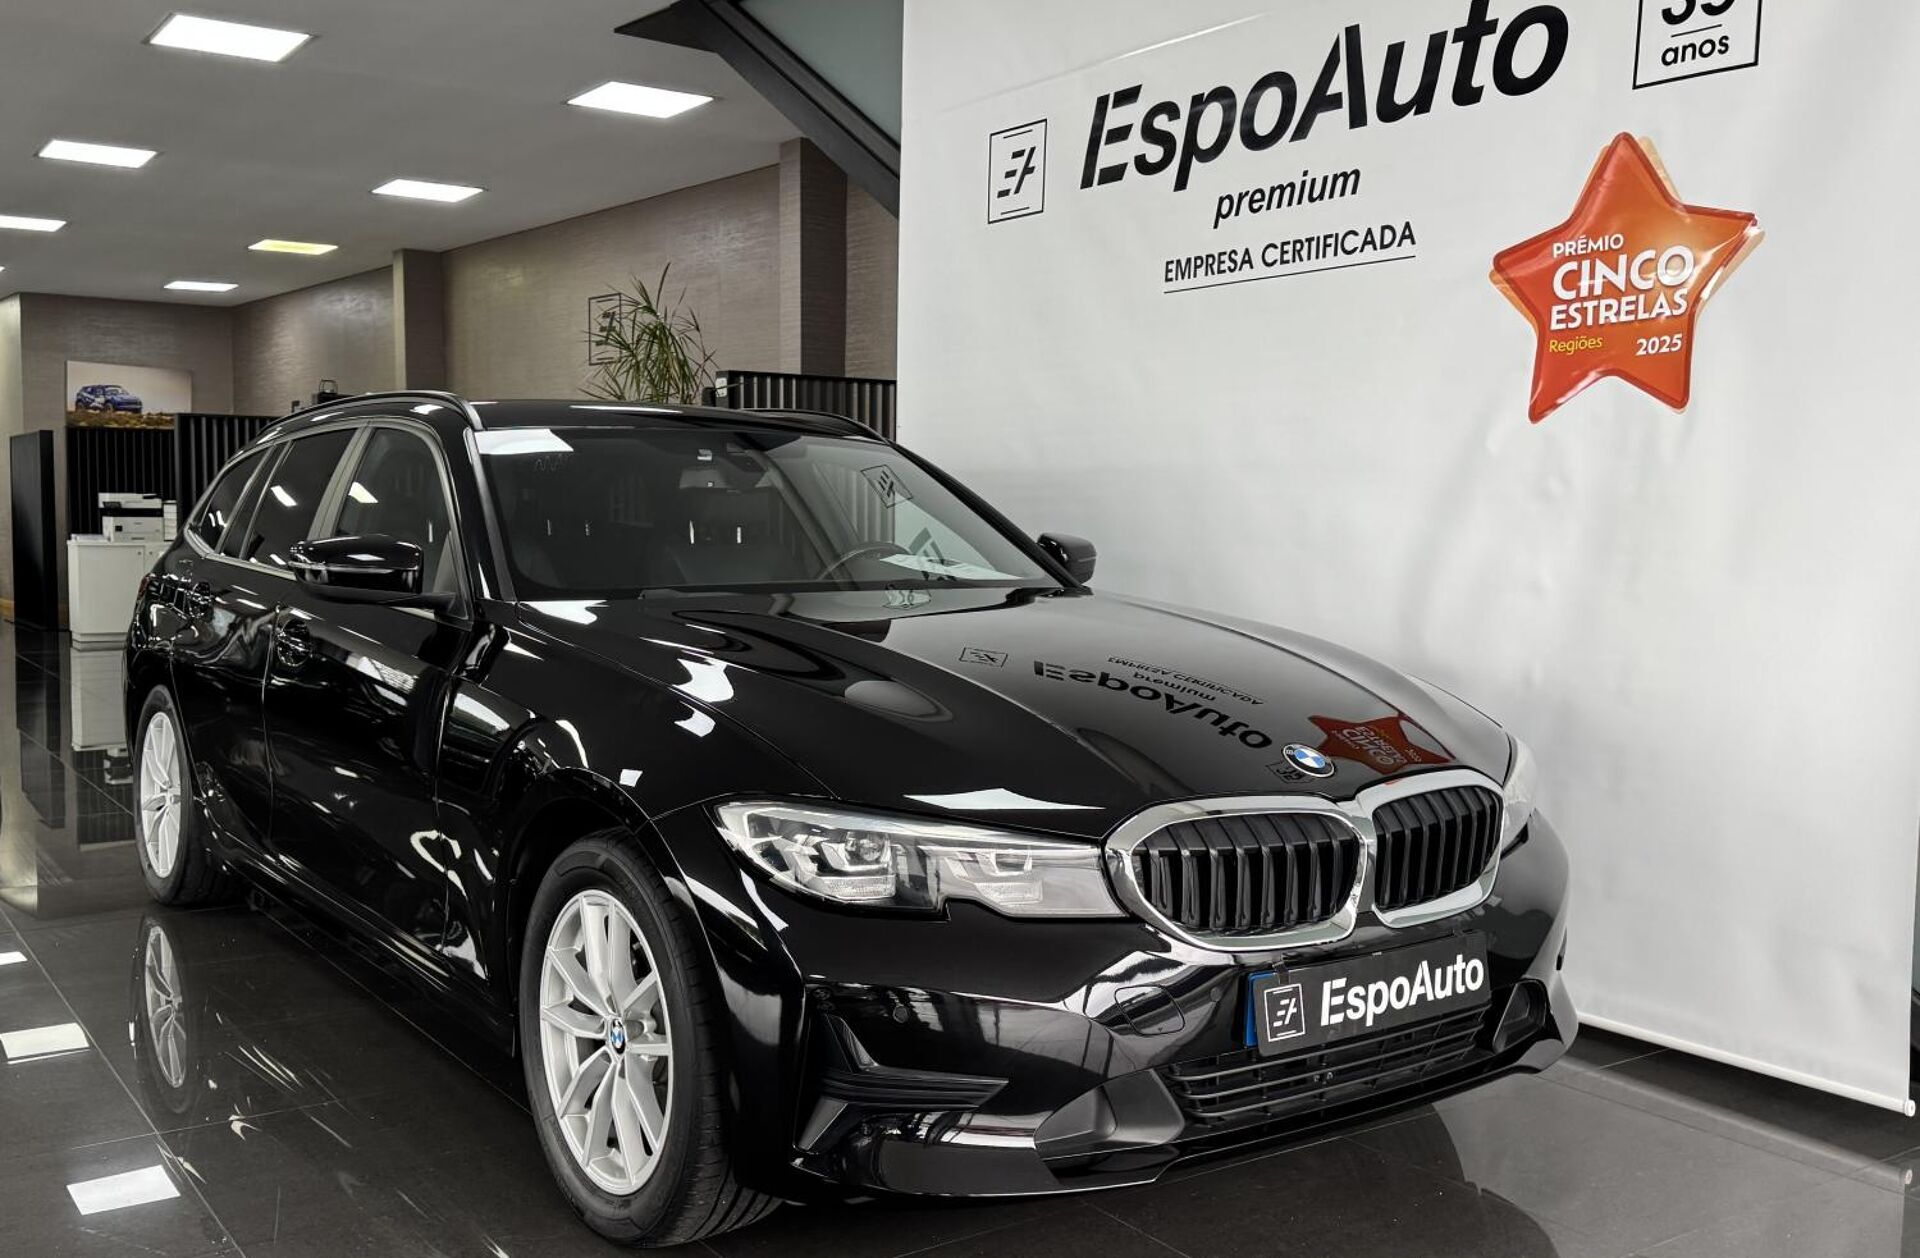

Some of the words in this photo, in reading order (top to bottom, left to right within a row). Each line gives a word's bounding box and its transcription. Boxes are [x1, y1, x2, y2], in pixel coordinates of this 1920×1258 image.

[1661, 35, 1730, 67] anos
[1080, 0, 1569, 193] EspoAuto
[1213, 168, 1361, 229] premium
[1164, 247, 1254, 283] EMPRESA
[1261, 221, 1417, 268] CERTIFICADA
[1552, 233, 1624, 259] PRÉMIO
[1552, 245, 1695, 300] CINCO
[1550, 288, 1688, 331] ESTRELAS
[1549, 336, 1603, 356] Regiões
[1635, 333, 1683, 356] 2025
[1320, 954, 1484, 1027] EspoAuto
